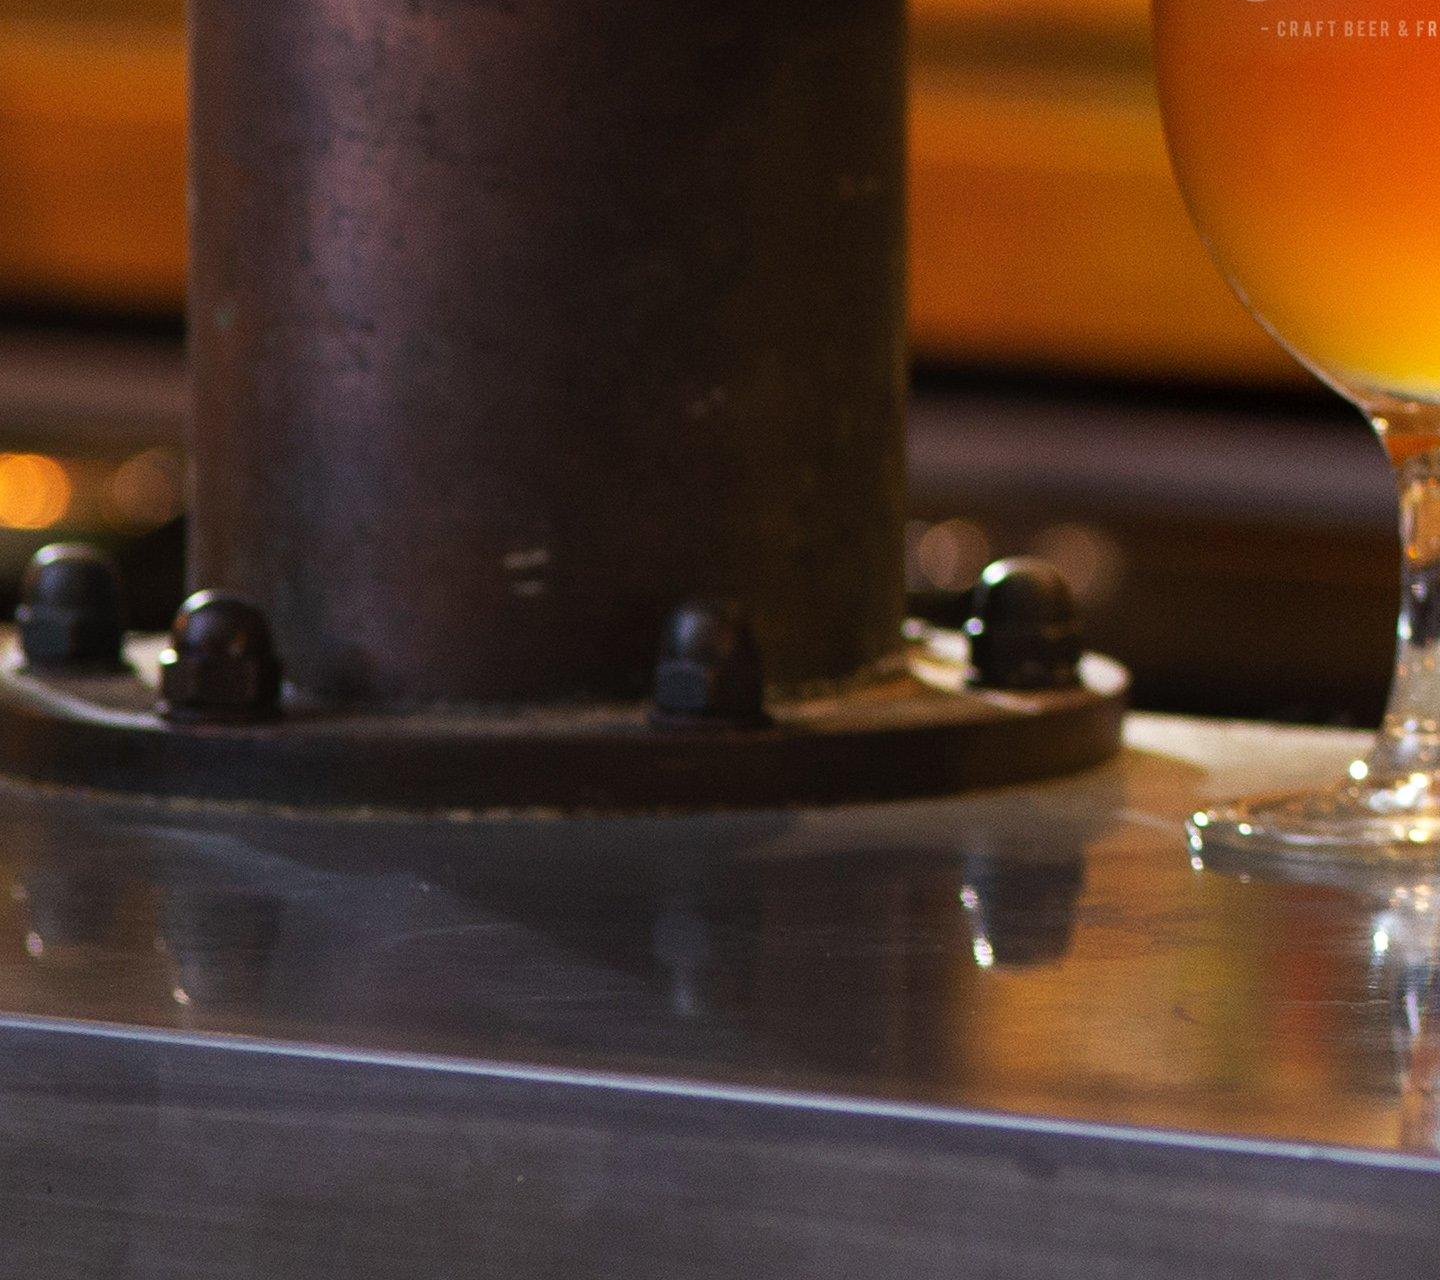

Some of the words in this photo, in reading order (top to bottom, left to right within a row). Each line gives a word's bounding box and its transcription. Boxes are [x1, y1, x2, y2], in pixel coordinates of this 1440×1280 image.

[1277, 20, 1336, 38] CRAFT
[1344, 20, 1390, 38] BEER
[1398, 20, 1408, 38] &
